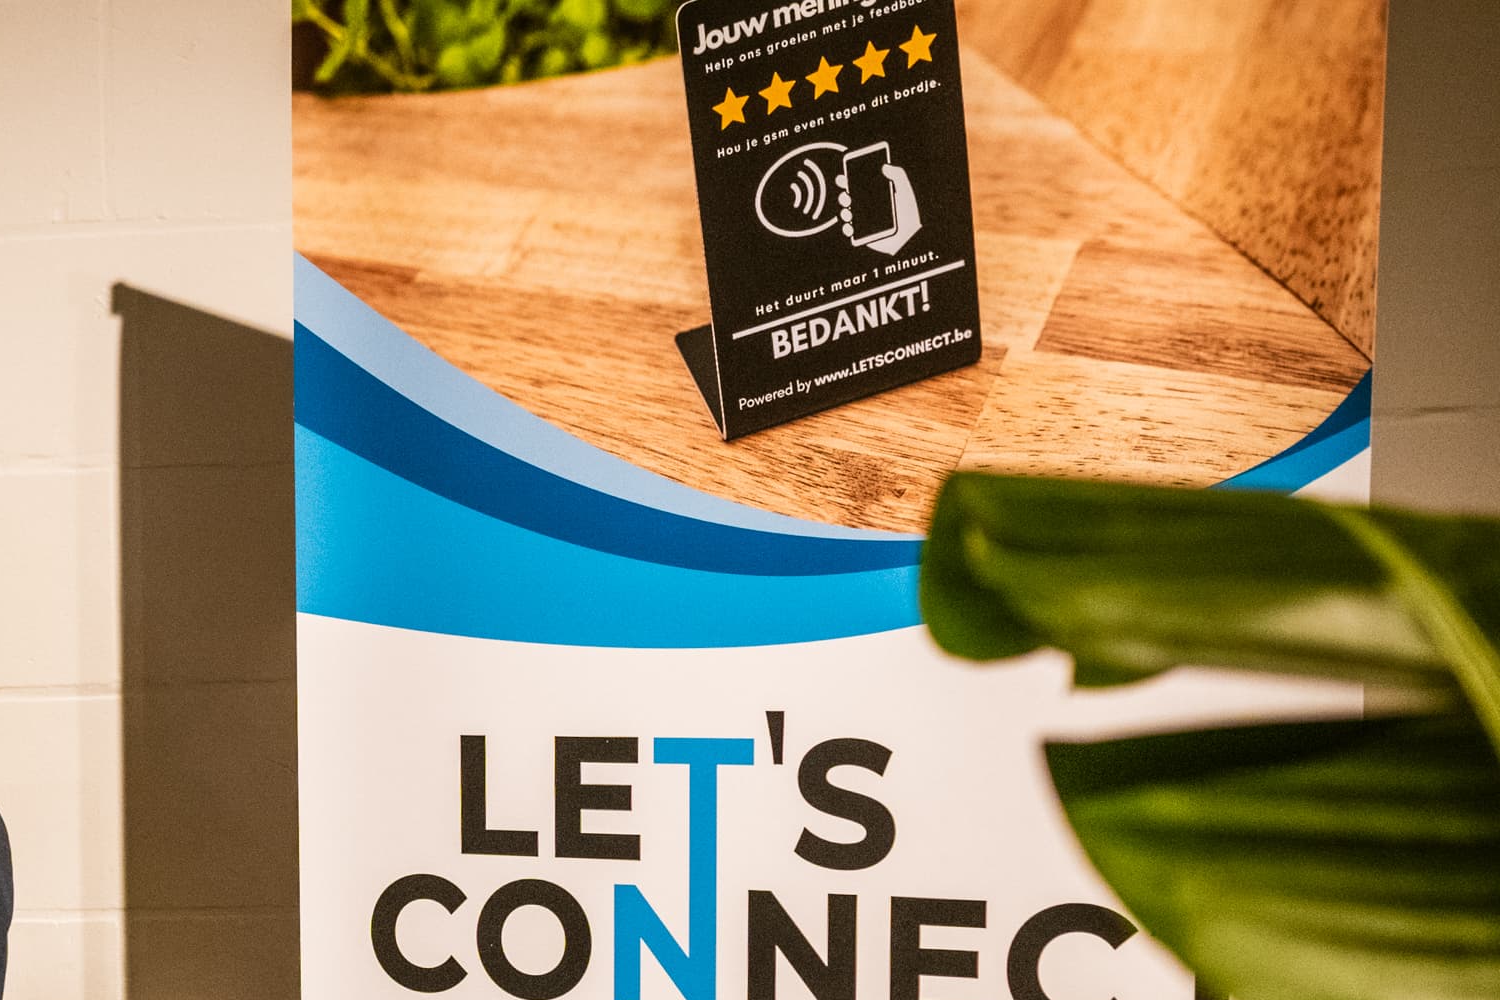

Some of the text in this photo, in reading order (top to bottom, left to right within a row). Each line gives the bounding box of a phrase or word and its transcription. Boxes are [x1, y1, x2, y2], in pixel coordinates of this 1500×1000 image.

[693, 12, 769, 55] Jouw
[705, 0, 926, 74] Help ons groeien met je feedba
[717, 79, 941, 158] Hou je gsm even tegen dit bordje.
[755, 251, 940, 317] Het duurt maar 1 minuut.
[771, 280, 930, 360] BEDANKT!
[738, 327, 973, 411] Powered by www.LETSCONNECT.be
[460, 711, 897, 870] LET'S
